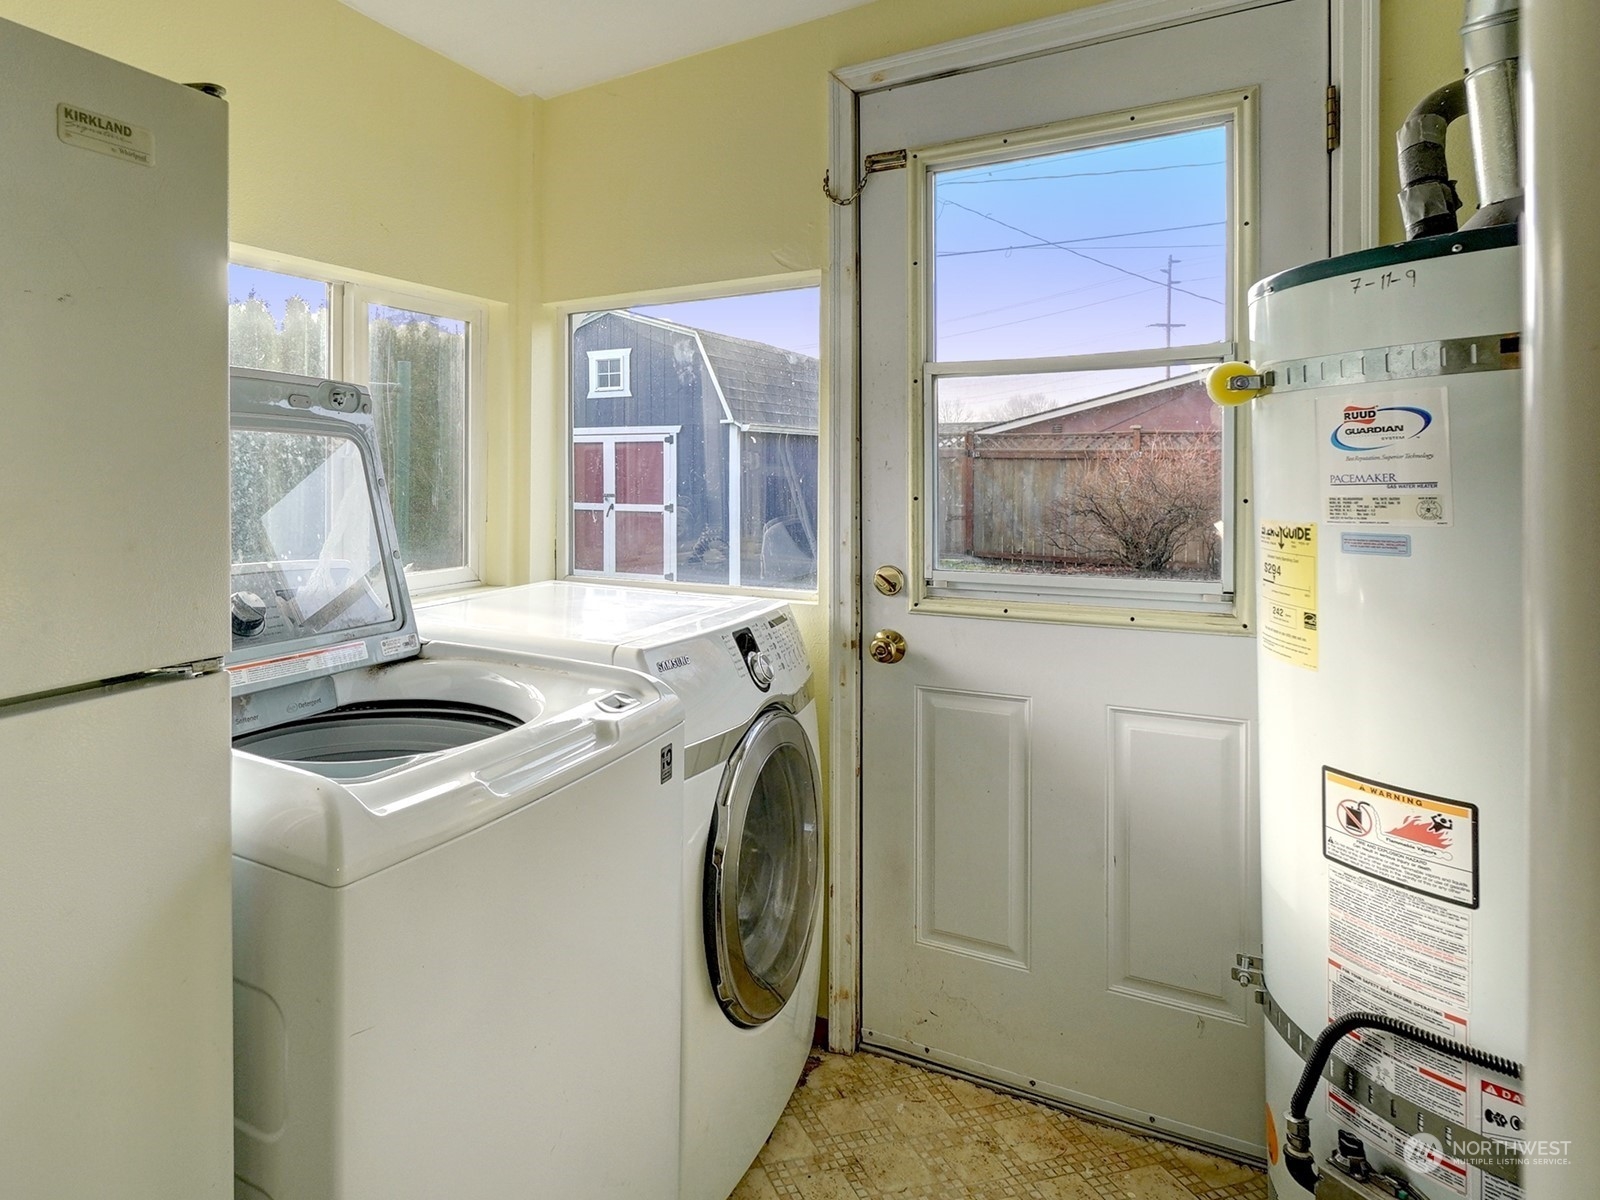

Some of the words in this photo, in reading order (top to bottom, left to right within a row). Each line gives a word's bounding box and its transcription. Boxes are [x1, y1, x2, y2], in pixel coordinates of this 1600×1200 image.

[64, 107, 132, 137] KIRKLAND
[1344, 410, 1376, 420] RUUD
[1345, 425, 1404, 435] GUARDIAN
[1330, 473, 1397, 483] PACEMAKER
[656, 656, 690, 672] SAMSUNG
[1370, 787, 1422, 806] WARNING
